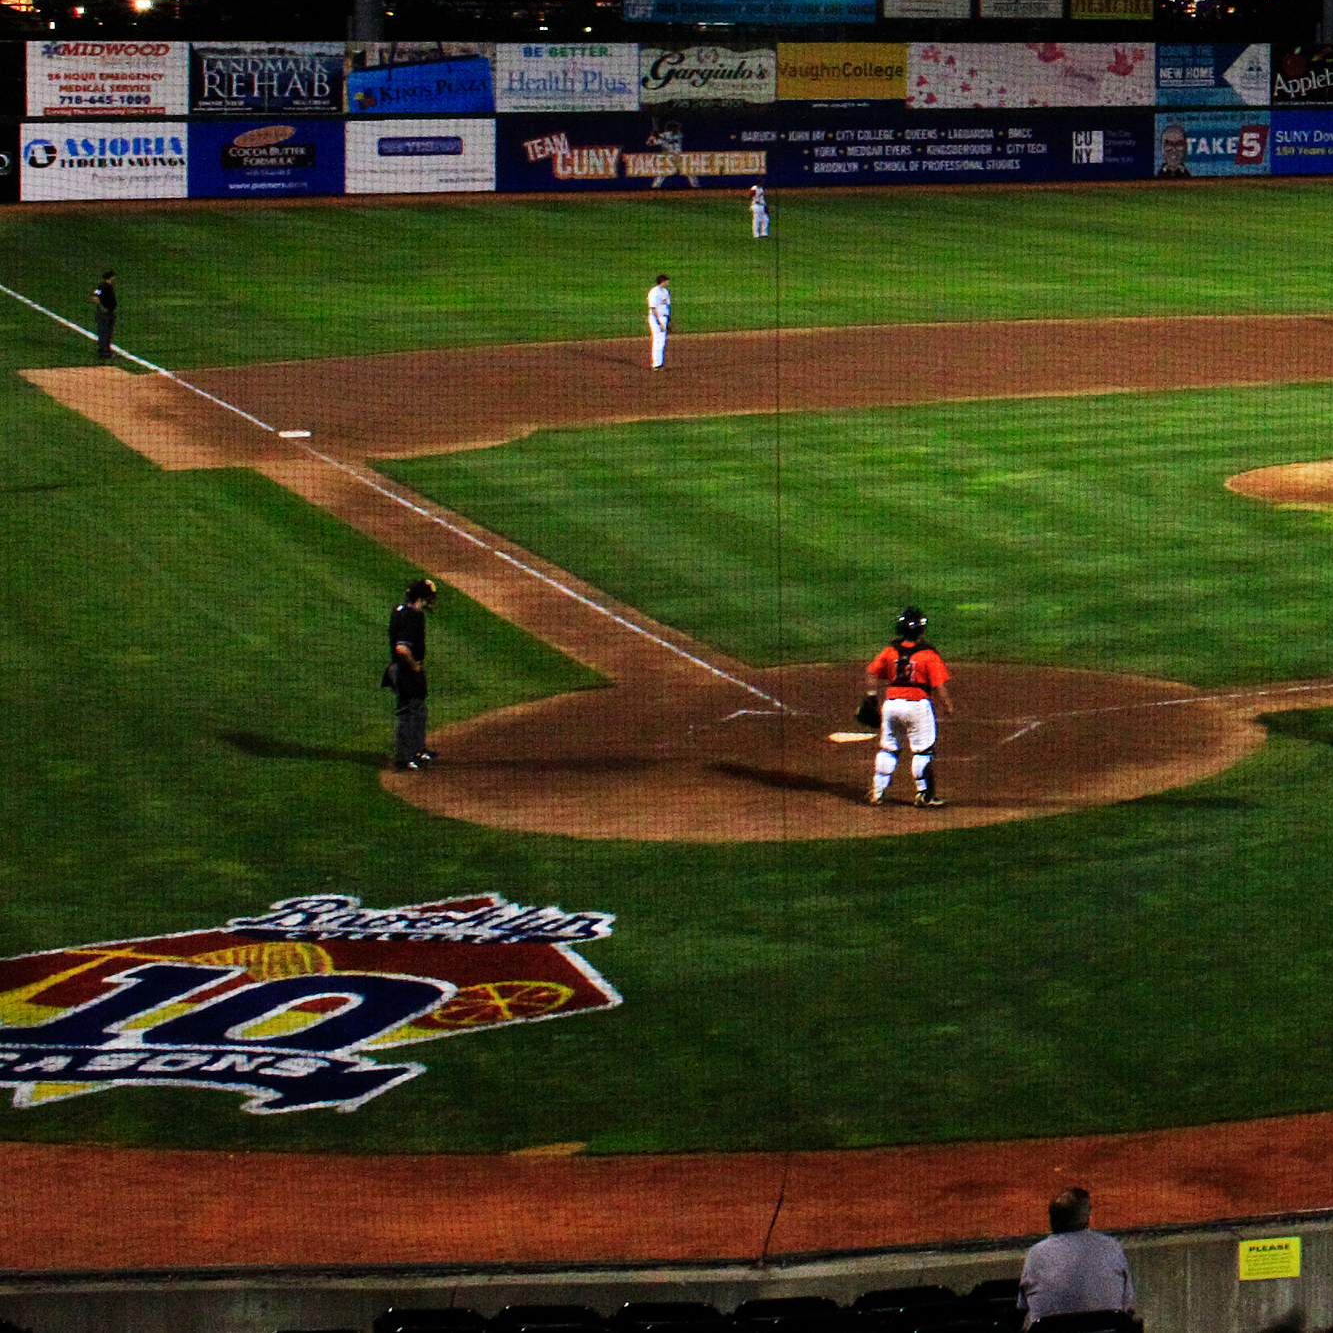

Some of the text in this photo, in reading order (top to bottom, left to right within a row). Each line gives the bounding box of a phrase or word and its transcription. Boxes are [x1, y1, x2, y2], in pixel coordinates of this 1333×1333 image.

[57, 43, 170, 57] MIDWOOD
[523, 47, 542, 57] BE
[203, 59, 329, 74] LANDMARK
[643, 51, 768, 91] Gargiulo's
[1160, 67, 1215, 78] NEW HOME
[59, 84, 151, 92] MEDICAL SERVICE
[204, 73, 331, 98] REHAB
[507, 70, 627, 92] Health Plus
[835, 130, 855, 141] CITY
[857, 130, 895, 140] COLLEGE
[904, 129, 938, 140] QUEENS
[1275, 130, 1310, 143] SUNY
[524, 132, 571, 161] TEAM
[885, 145, 912, 156] EVERS
[1006, 144, 1025, 154] CITY
[1187, 132, 1261, 157] TAKE 5
[556, 147, 622, 175] CUNY
[626, 154, 678, 174] TAKES
[679, 153, 712, 174] THE
[813, 162, 859, 173] BROOKLYN
[873, 161, 906, 172] SCHOOL
[908, 160, 920, 171] OF
[922, 159, 985, 171] PROFESSIONAL
[0, 962, 458, 1053] 10
[1249, 1244, 1291, 1253] PLEASE
